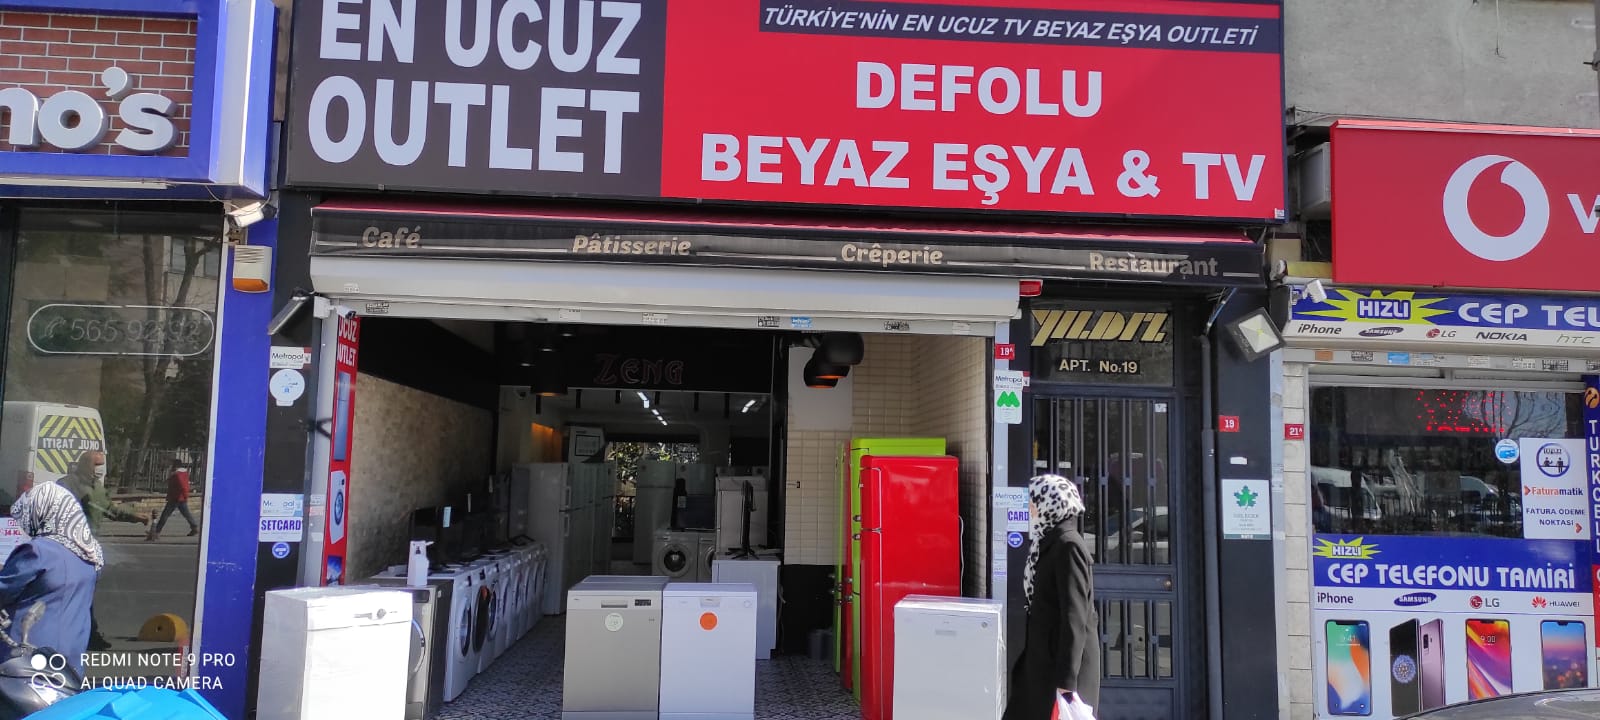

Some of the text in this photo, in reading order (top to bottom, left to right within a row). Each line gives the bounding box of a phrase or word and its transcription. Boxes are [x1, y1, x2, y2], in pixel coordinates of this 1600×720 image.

[320, 0, 641, 74] EN UCUZ
[764, 5, 1259, 45] TÜRKİYE'NİN EN UCUZ TV BEYAZ EŞYA OUTLETİ
[856, 61, 1102, 117] DEFOLU
[308, 75, 641, 174] OUTLET
[701, 133, 1266, 205] BEYAZ EŞYA & TV
[362, 225, 1218, 277] Café Pâtisserie Crêperie Restaurant
[1358, 299, 1410, 319] HIZLI
[1458, 302, 1529, 325] CEP
[70, 319, 118, 342] 565
[338, 317, 358, 343] UCUZ
[1030, 309, 1169, 347] YILDIZ
[1297, 323, 1342, 335] iPhone
[1441, 330, 1457, 338] LG
[1475, 331, 1528, 341] NOKIA
[337, 343, 357, 367] UTLET
[1058, 359, 1091, 372] APT.
[1531, 486, 1584, 496] Faturamatik
[261, 519, 302, 531] SETCARD
[1007, 511, 1029, 521] CARD
[1332, 545, 1362, 557] HIZLI
[1328, 563, 1369, 584] CEP
[1375, 564, 1490, 587] TELEFONU
[1499, 563, 1576, 589] TAMİRİ
[1316, 592, 1354, 604] iPhone
[1485, 598, 1500, 608] LG
